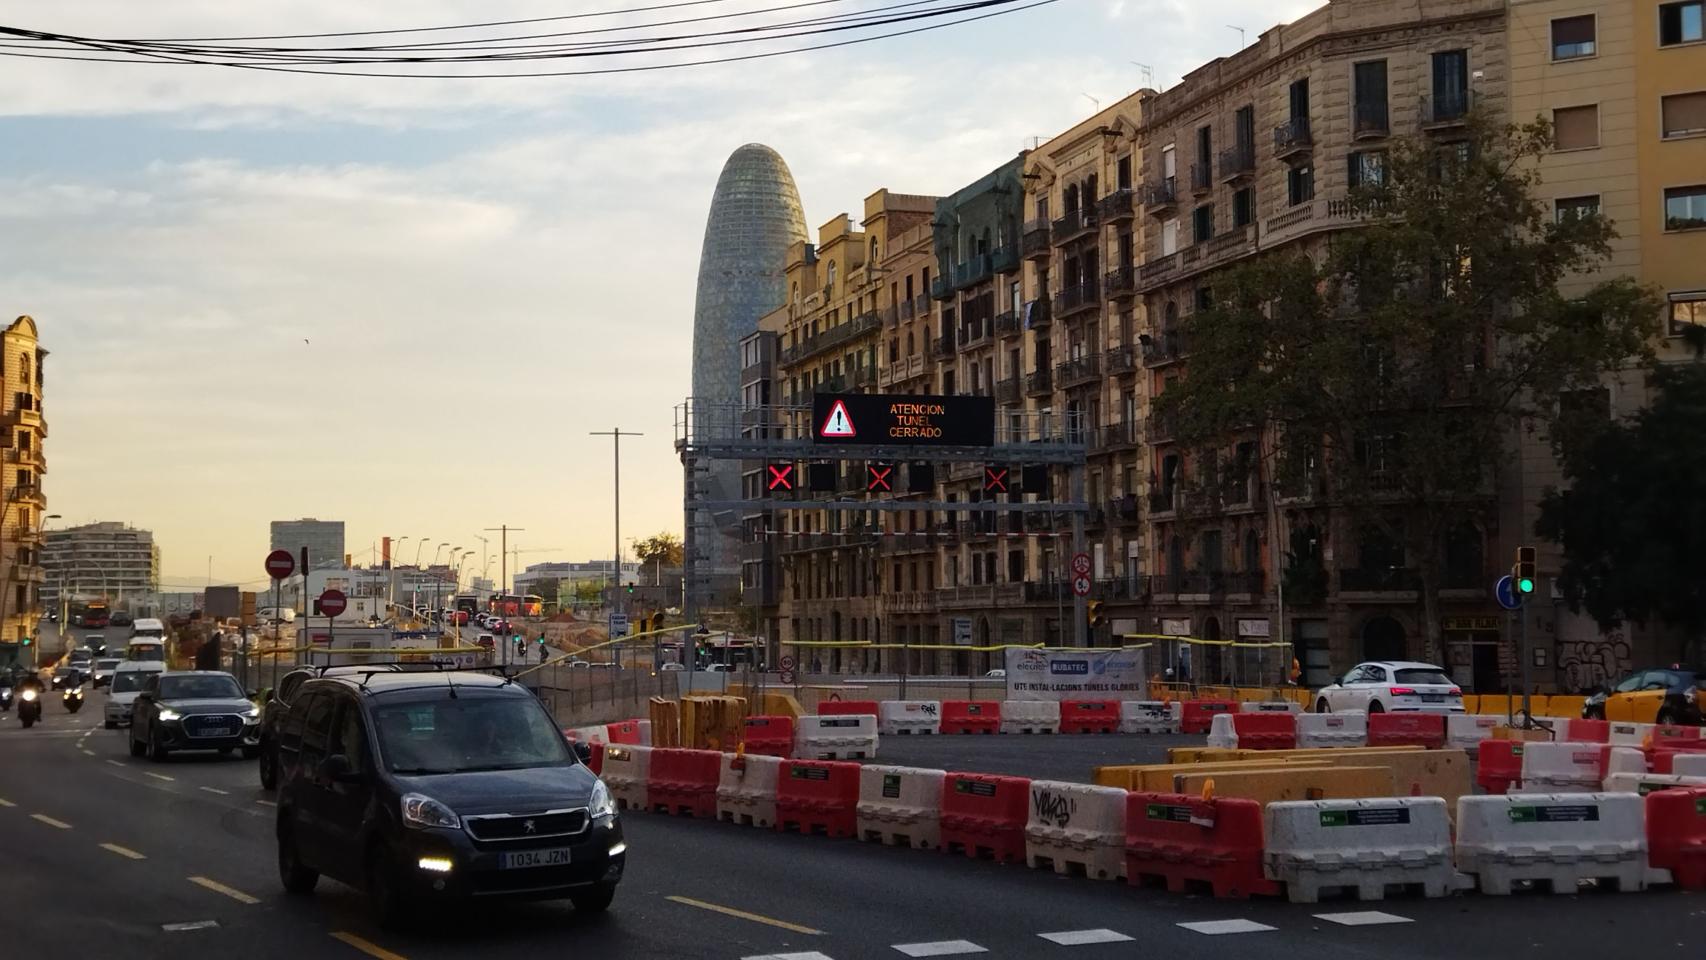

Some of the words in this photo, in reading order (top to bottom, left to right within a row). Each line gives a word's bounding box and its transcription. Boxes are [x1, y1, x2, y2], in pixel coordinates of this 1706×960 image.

[890, 404, 945, 415] ATENCION
[896, 415, 932, 426] TUNEL
[889, 427, 943, 438] CERRADO
[1052, 662, 1087, 672] RUBATEC
[510, 852, 541, 867] 1034
[545, 850, 569, 864] JZN
